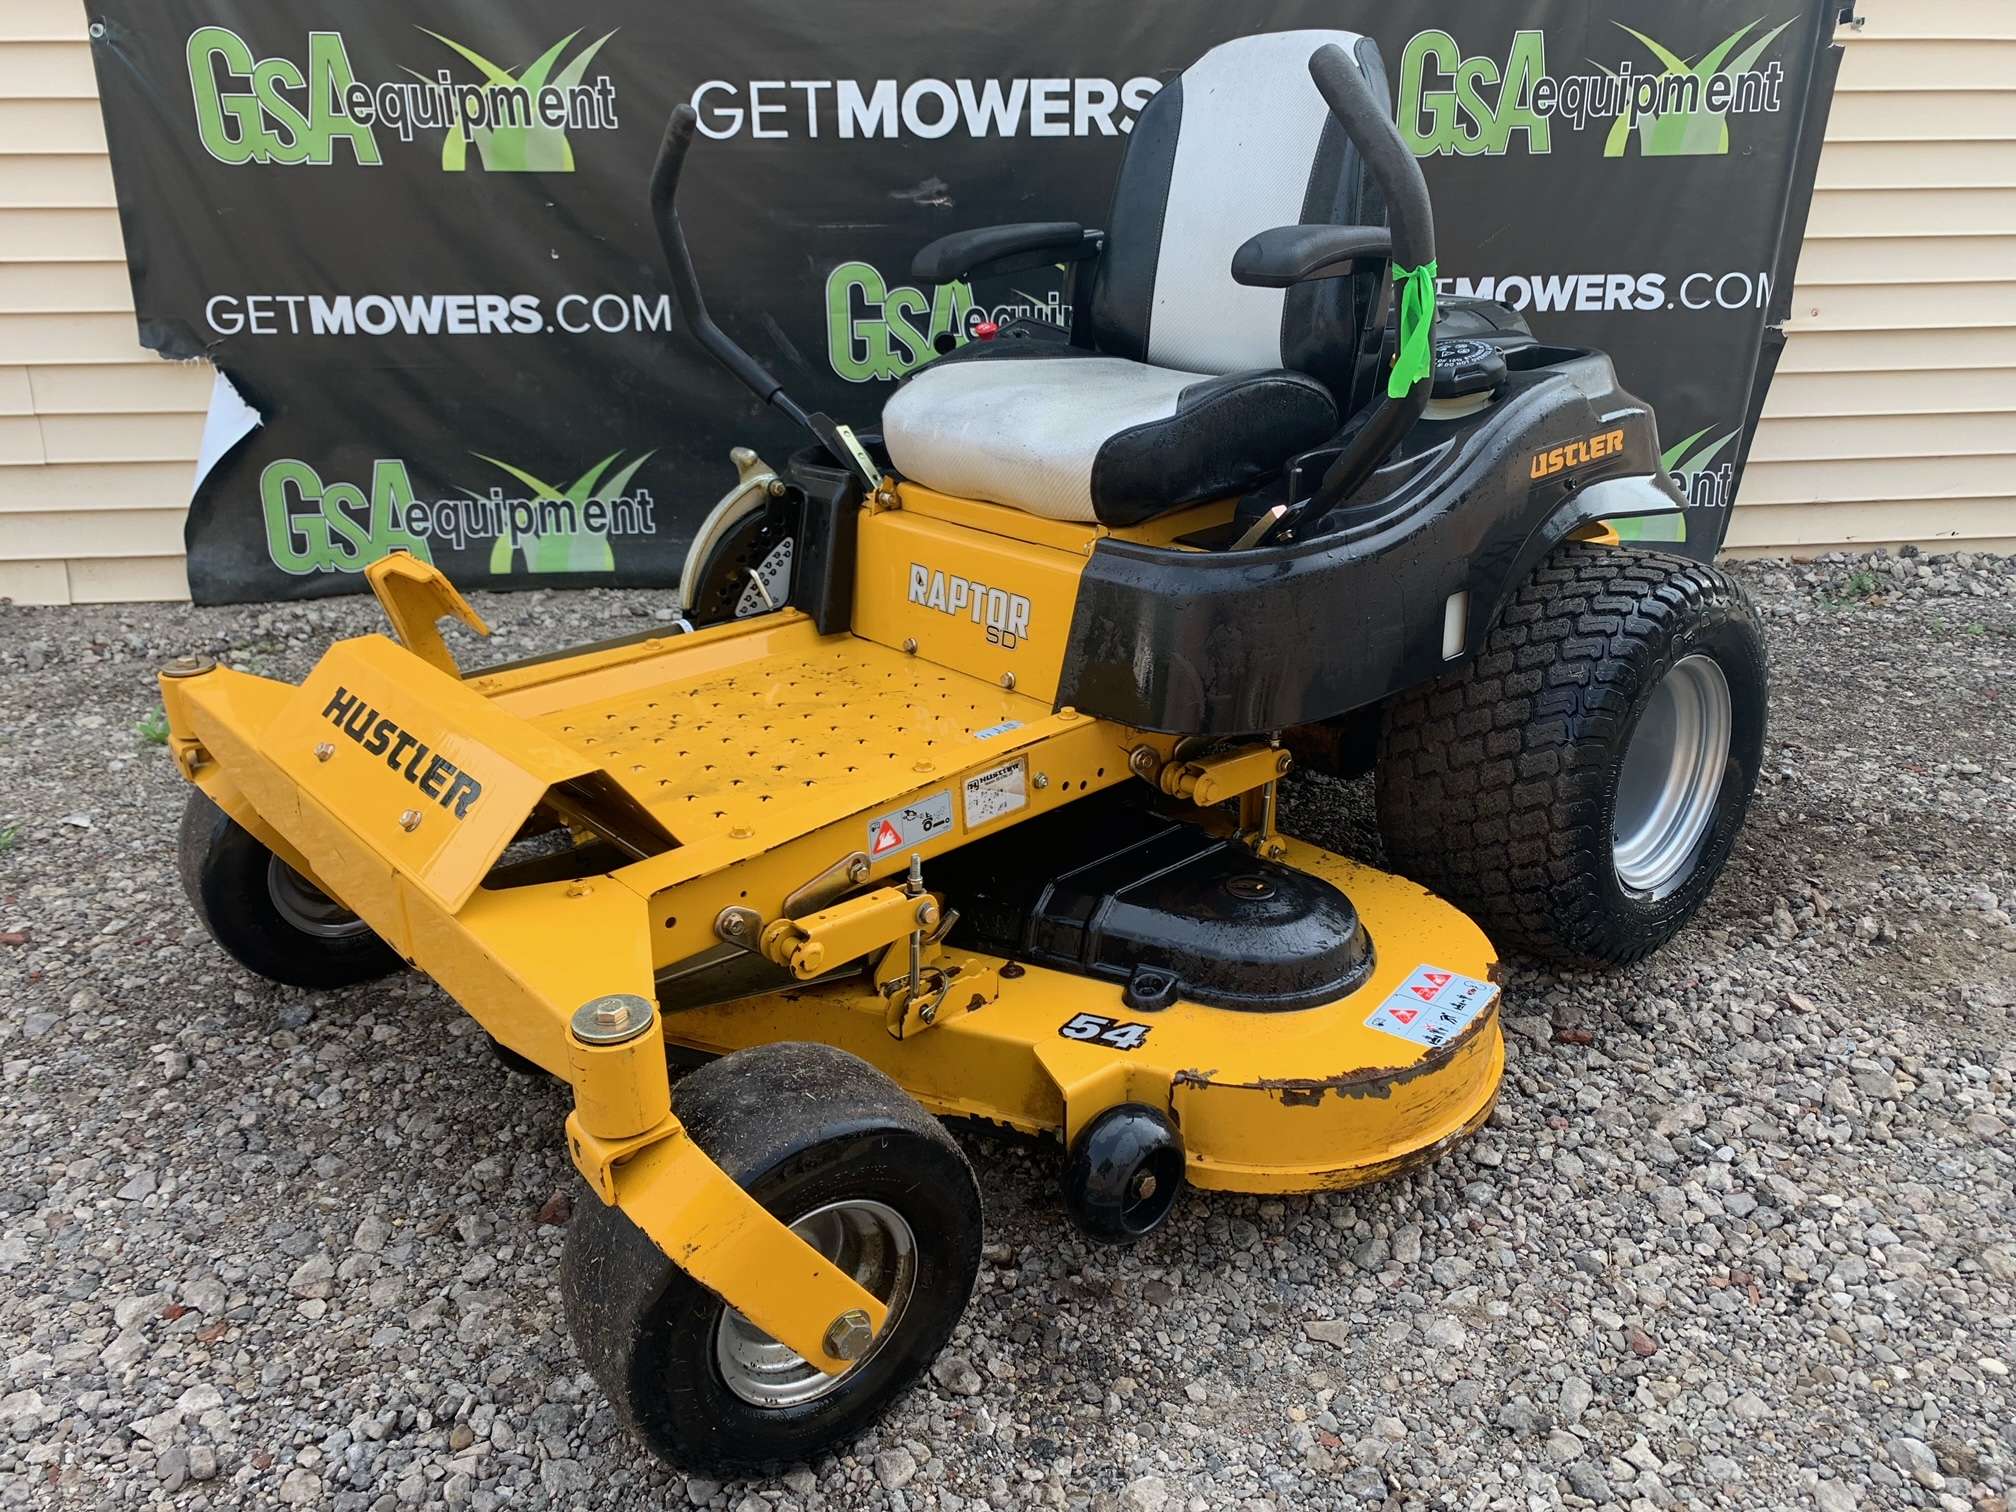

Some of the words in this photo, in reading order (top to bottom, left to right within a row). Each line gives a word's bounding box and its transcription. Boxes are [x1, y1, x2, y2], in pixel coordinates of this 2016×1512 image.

[343, 69, 618, 142] equipment
[1528, 61, 1784, 131] equipment
[205, 294, 672, 335] GETMOWERS.COM
[402, 488, 656, 550] equipment
[908, 562, 1031, 640] RAPTOR
[985, 625, 1017, 650] SD
[322, 686, 484, 820] HUSTLER
[1060, 1014, 1149, 1050] 54
